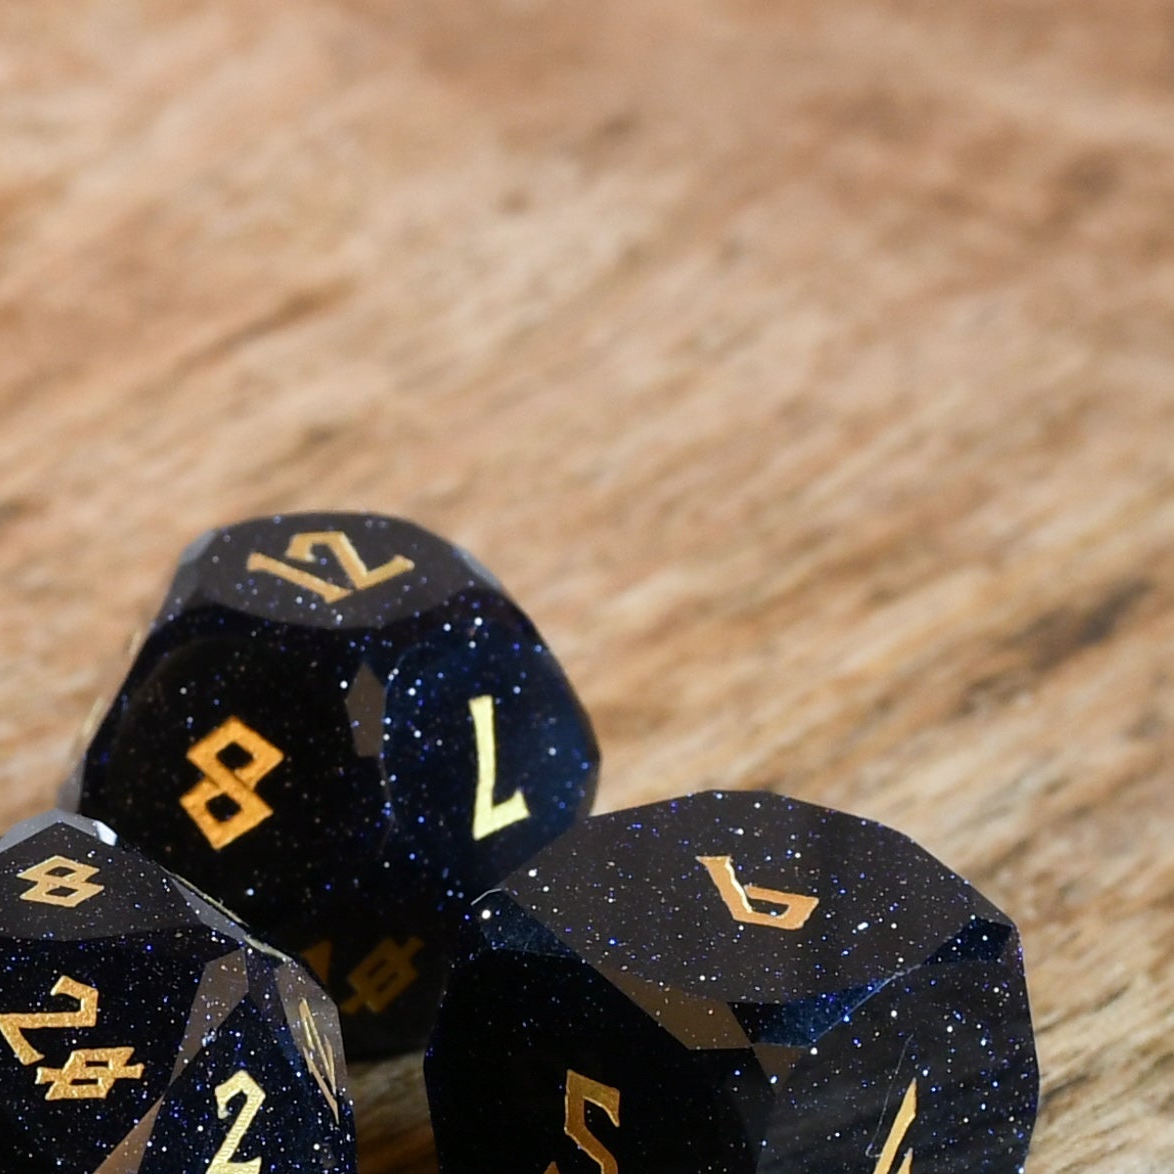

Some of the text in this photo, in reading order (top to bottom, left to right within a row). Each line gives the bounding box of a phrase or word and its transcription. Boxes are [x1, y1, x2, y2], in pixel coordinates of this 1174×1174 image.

[246, 530, 416, 603] 12
[180, 714, 286, 852] 8
[468, 693, 531, 842] 7
[16, 854, 105, 908] 8
